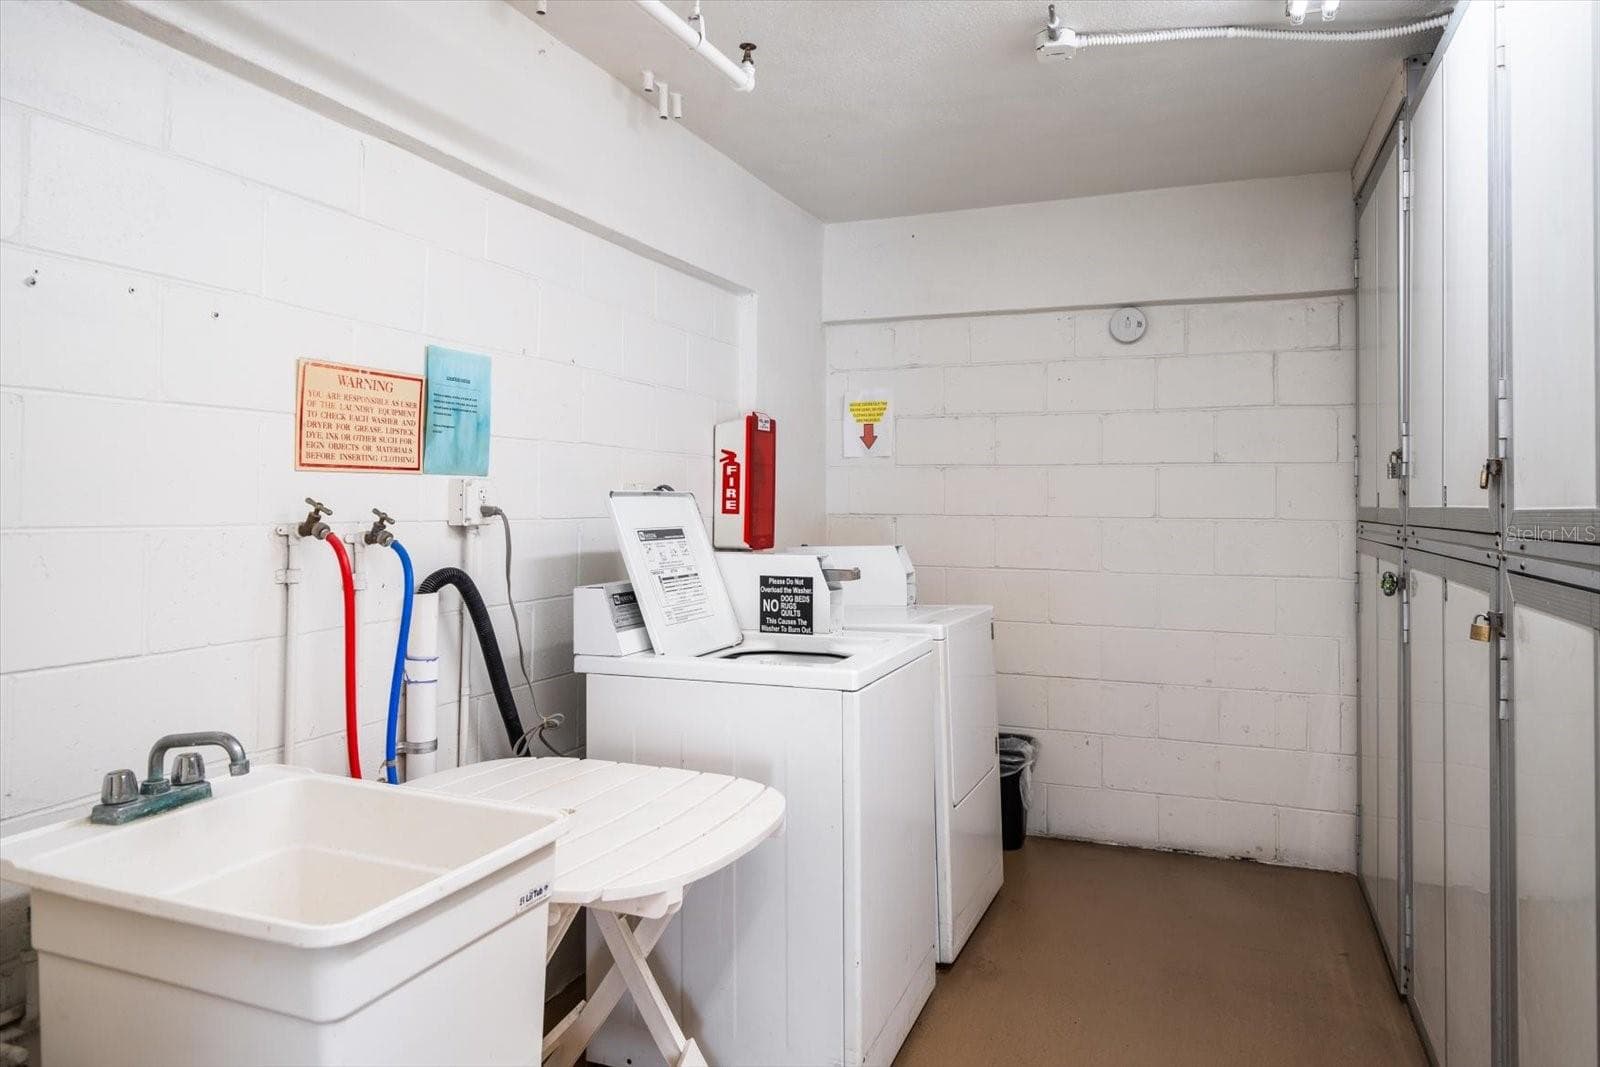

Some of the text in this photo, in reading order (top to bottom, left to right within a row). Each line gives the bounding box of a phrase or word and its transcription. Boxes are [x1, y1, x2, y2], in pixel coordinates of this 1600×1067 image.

[337, 375, 394, 394] WARNING
[308, 390, 322, 398] YOU
[327, 392, 340, 400] ARE
[344, 394, 389, 405] RESPONSIBLE
[400, 400, 417, 408] USER
[320, 400, 335, 409] THE
[340, 403, 374, 414] LAUNDRY
[378, 406, 416, 417] EQUIPMENT
[320, 411, 346, 420] CHECK
[349, 414, 368, 422] EACH
[372, 416, 398, 425] WASHER
[306, 420, 332, 430] DRYER
[336, 423, 350, 431] FOR
[326, 432, 338, 440] INK
[353, 434, 377, 443] OTHER
[328, 442, 359, 451] OBJECTS
[376, 445, 412, 454] MATERIALS
[306, 452, 415, 464] BEFORE INSERTING CLOTHING
[725, 465, 737, 509] FIRE
[763, 598, 779, 612] NO
